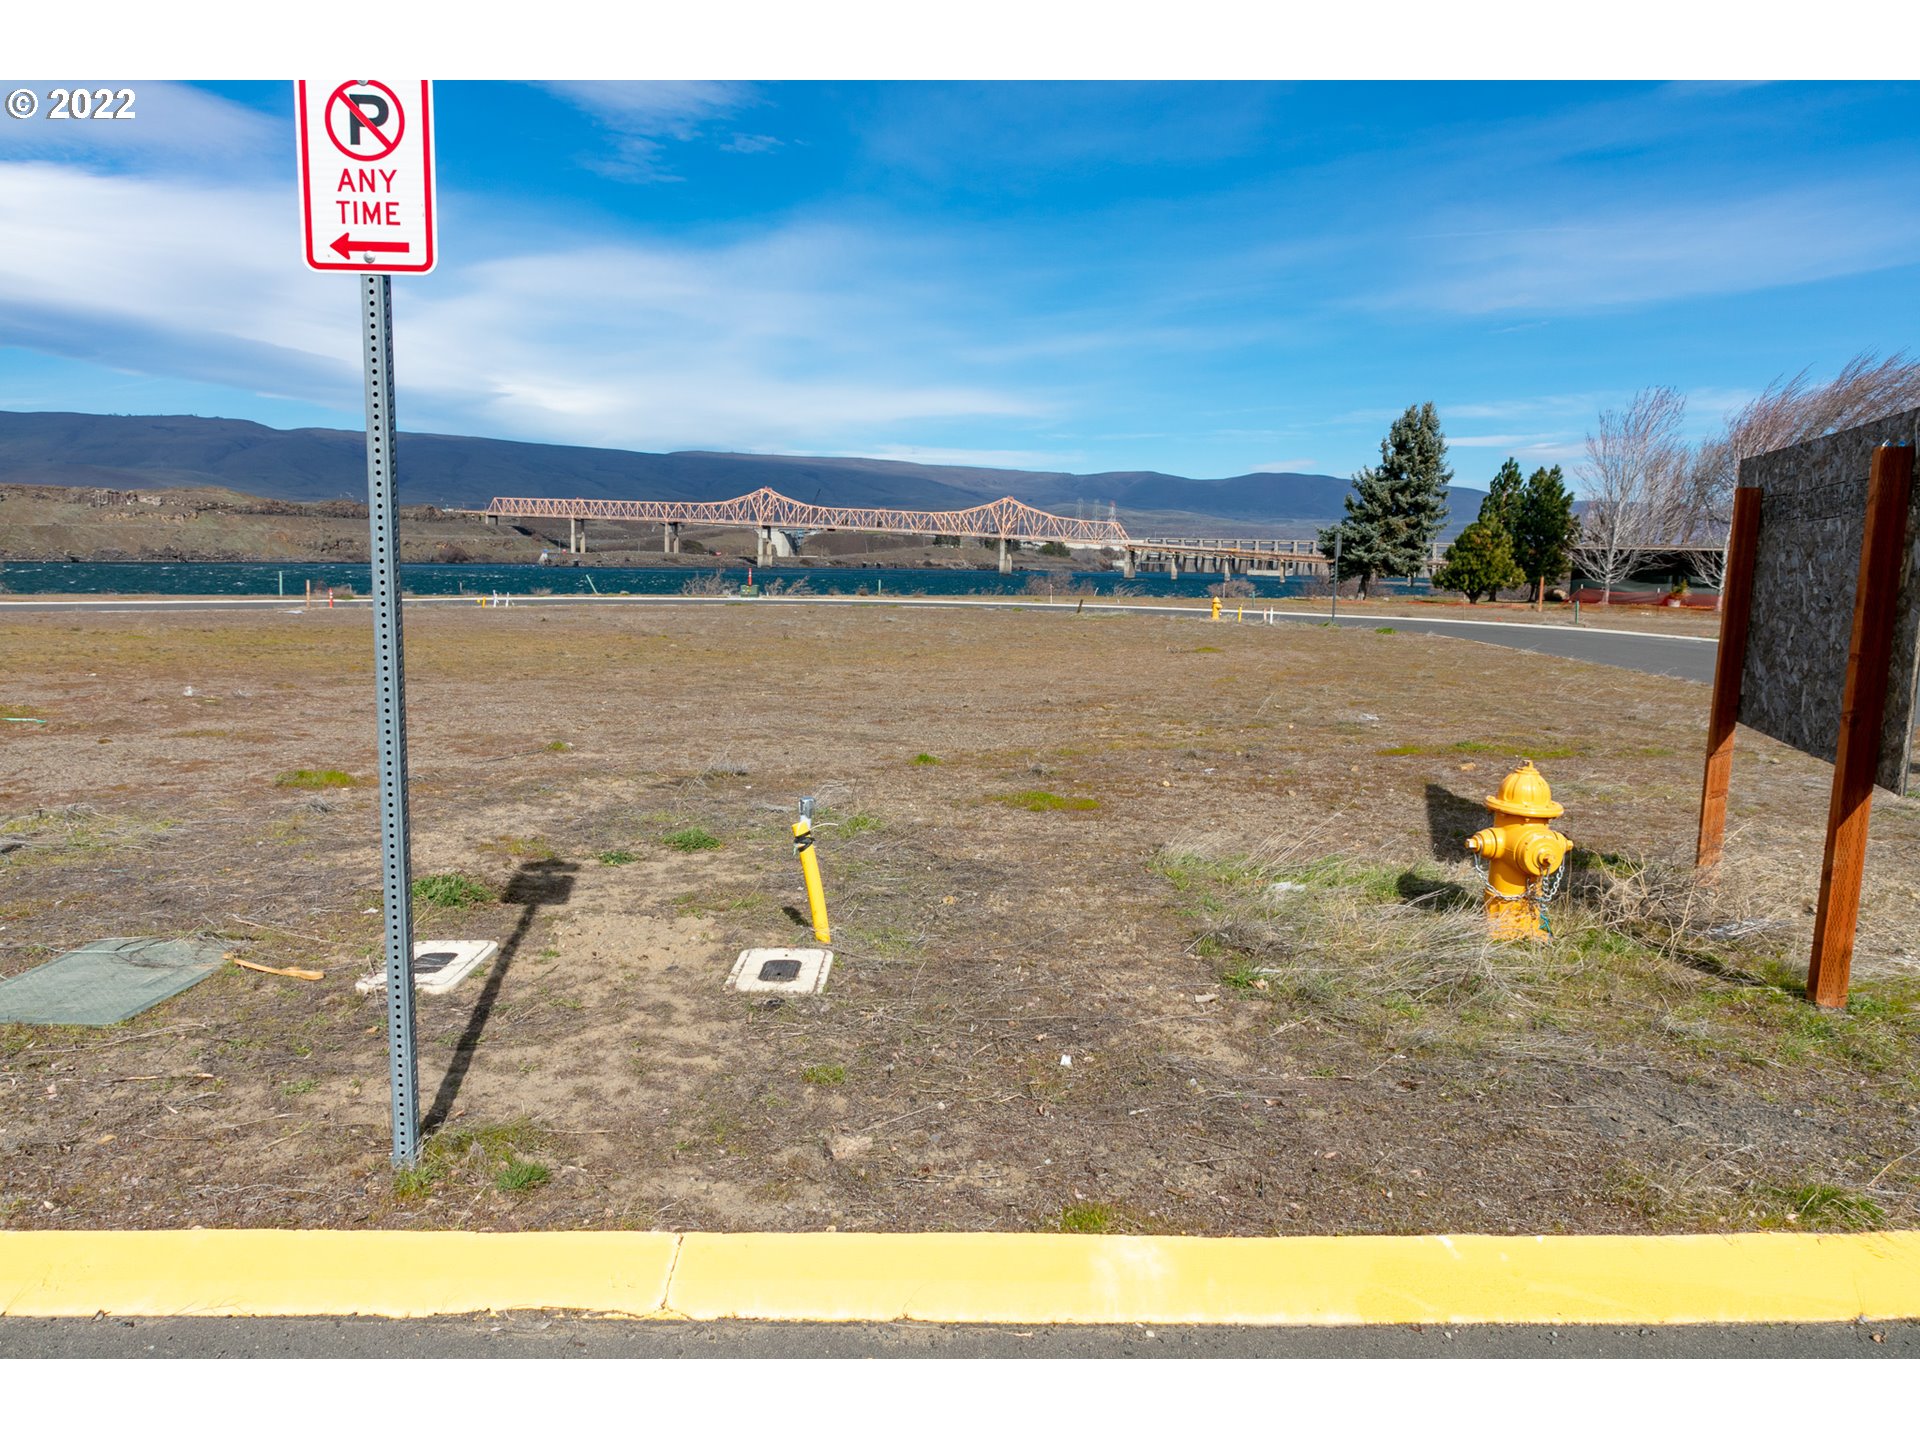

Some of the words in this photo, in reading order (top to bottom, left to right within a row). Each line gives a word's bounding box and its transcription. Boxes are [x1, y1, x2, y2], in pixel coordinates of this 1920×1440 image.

[349, 94, 389, 145] P
[337, 168, 398, 193] ANY
[336, 200, 401, 226] TIME
